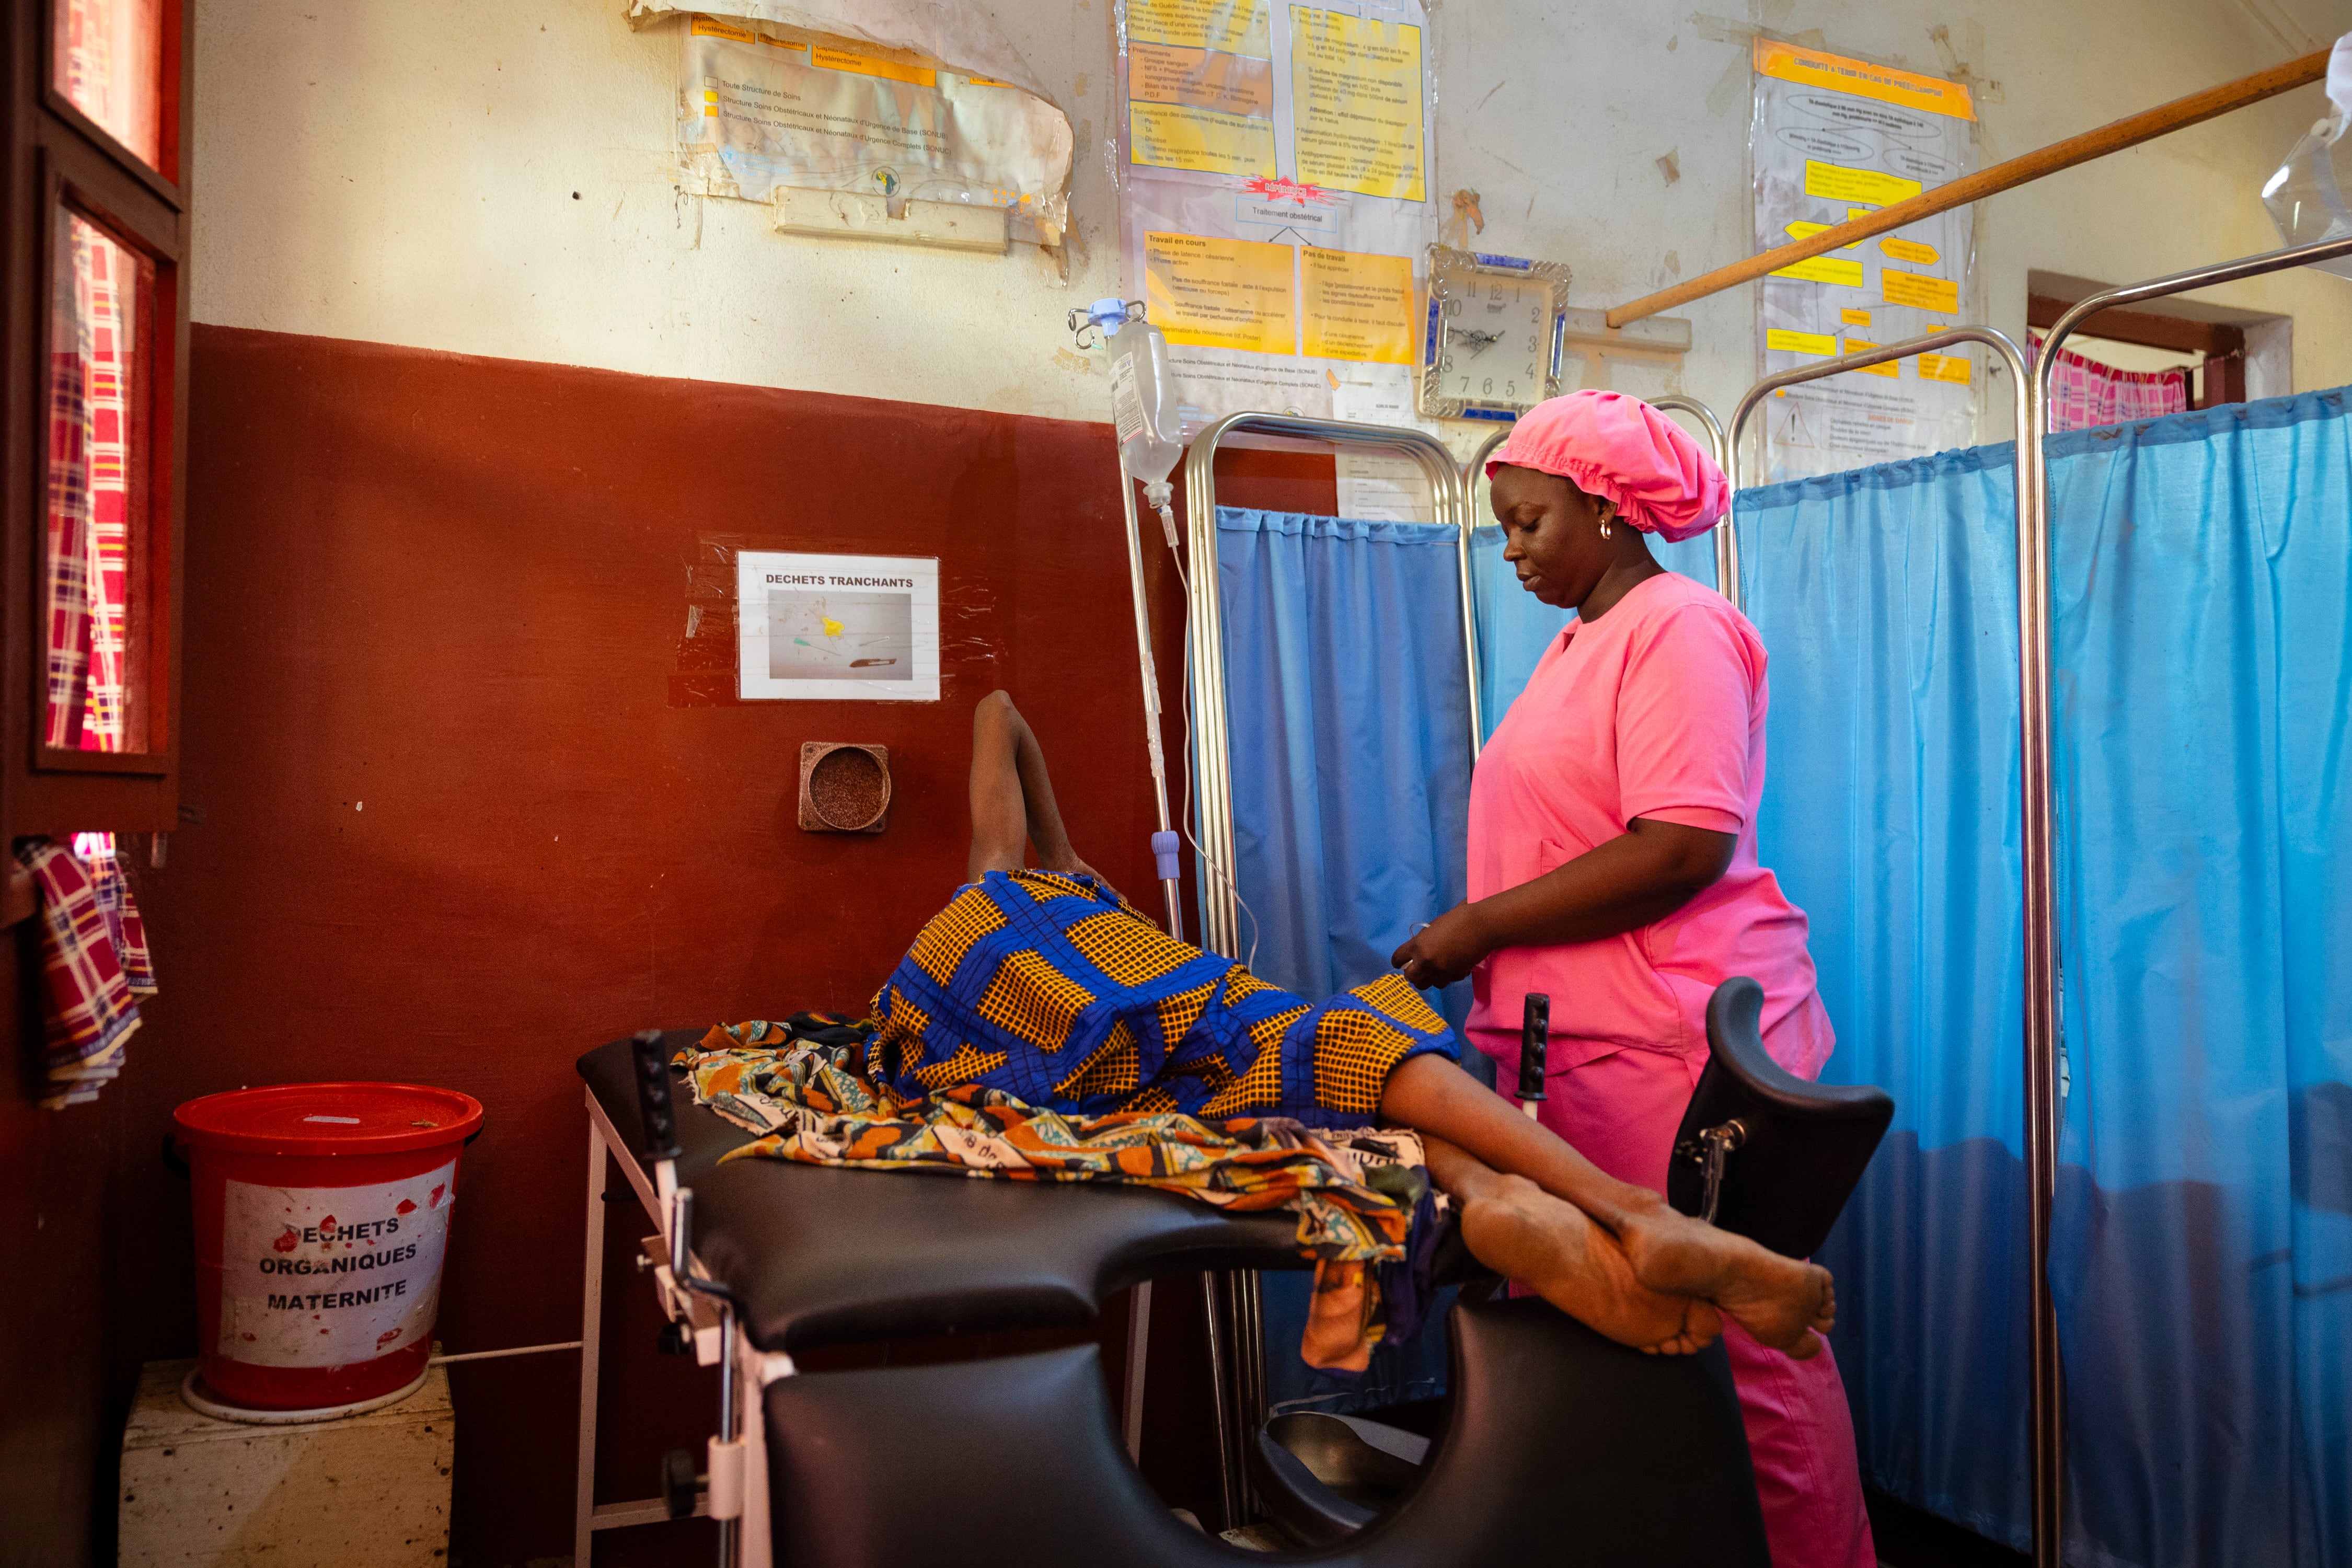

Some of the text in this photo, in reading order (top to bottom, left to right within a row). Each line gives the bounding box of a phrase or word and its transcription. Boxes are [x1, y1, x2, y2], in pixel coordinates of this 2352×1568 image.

[698, 25, 746, 38] Hystérectomie
[816, 53, 861, 66] Hystérectomie
[722, 80, 740, 89] Toute
[742, 84, 771, 95] Structure
[783, 92, 801, 101] Soins
[723, 96, 752, 107] Structure
[754, 101, 772, 110] Soins
[774, 105, 814, 118] Obstétricaux
[824, 113, 858, 124] Néonataux
[860, 119, 891, 131] d'Urgence
[919, 130, 948, 141] (SONUB)
[723, 111, 751, 122] Structure
[754, 117, 771, 126] Soins
[773, 121, 814, 132] Obstétricaux
[823, 128, 858, 139] Néonataux
[859, 134, 891, 144] d'Urgence
[893, 139, 921, 149] Complets
[923, 144, 951, 156] (SONUC)
[1252, 207, 1322, 222] Traitement obstétrical
[1467, 281, 1476, 298] 11
[1490, 284, 1502, 301] 12
[1516, 286, 1520, 303] 1
[1447, 299, 1462, 316] 10
[1531, 307, 1540, 324] 2
[1528, 336, 1537, 353] 3
[1443, 355, 1454, 373] 8
[1526, 363, 1534, 379] 4
[1460, 376, 1470, 393] 7
[1483, 377, 1493, 395] 6
[1506, 381, 1515, 397] 5
[766, 574, 913, 588] DECHETS TRANCHANTS
[259, 1243, 417, 1276] ORGANIQUES
[268, 1279, 407, 1311] MATERNITE
